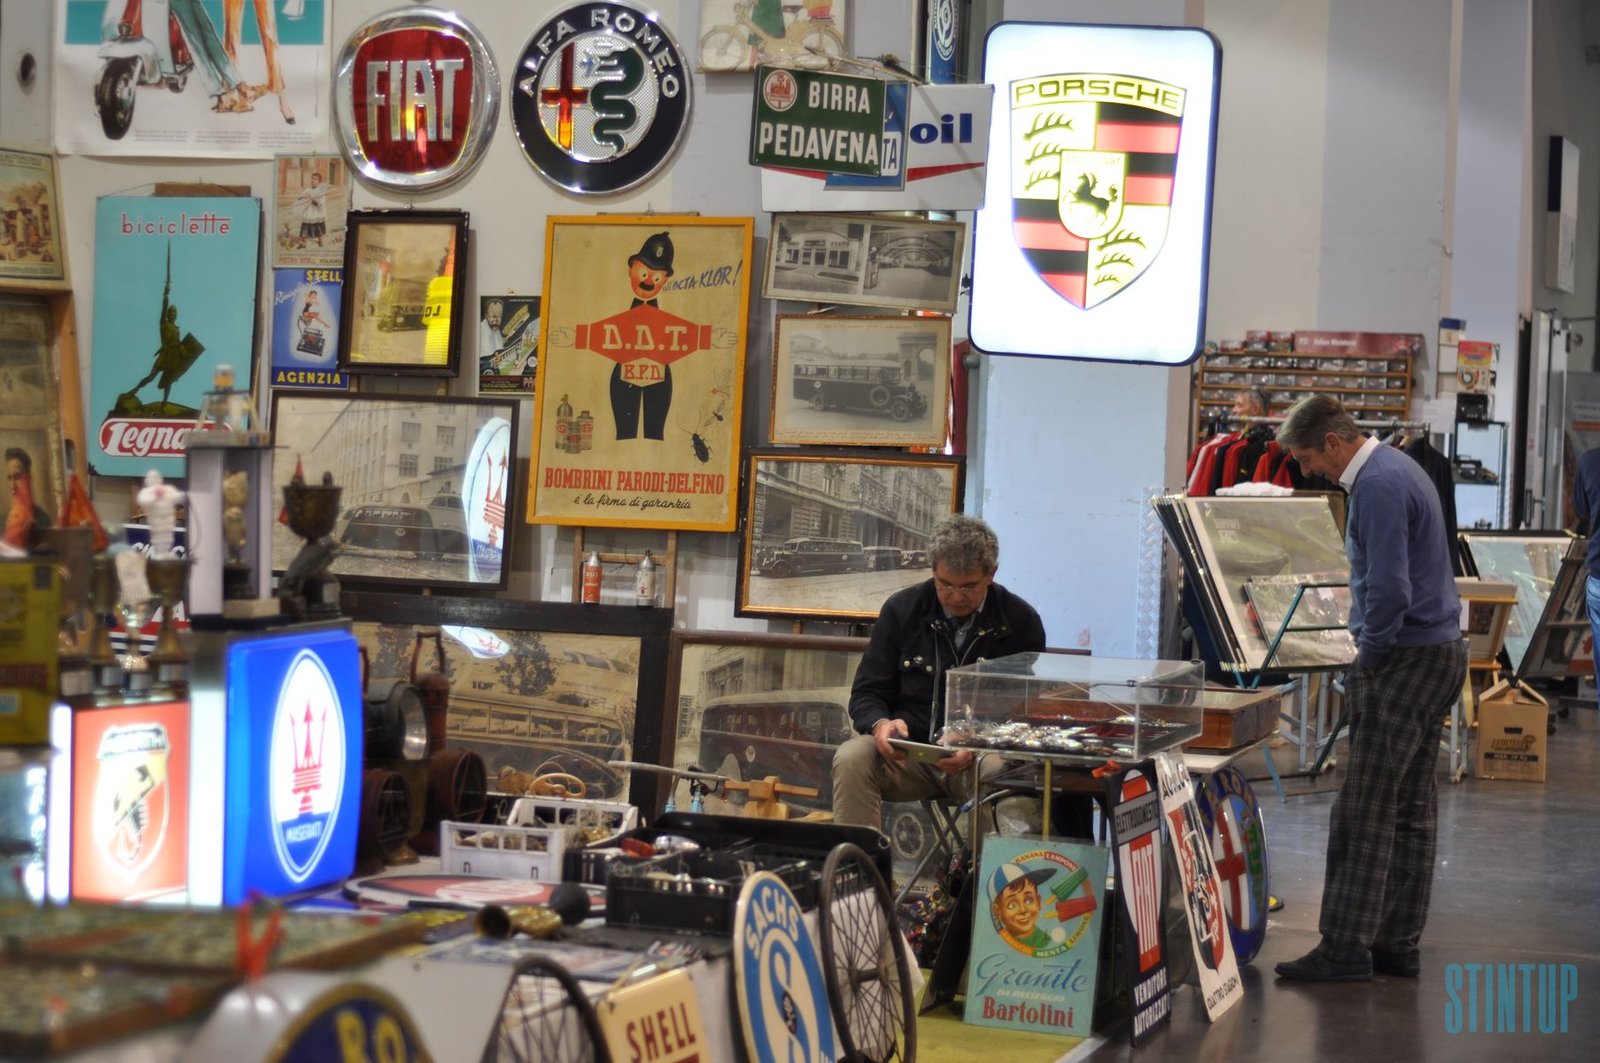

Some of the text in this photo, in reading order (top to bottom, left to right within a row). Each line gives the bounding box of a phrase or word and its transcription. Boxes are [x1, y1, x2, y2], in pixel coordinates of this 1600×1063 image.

[519, 8, 680, 99] ALFA ROMEO
[366, 58, 464, 142] FIAT
[808, 80, 871, 115] BIRRA
[1015, 79, 1180, 110] PORSCHE
[758, 121, 879, 166] PEDAVENA
[121, 213, 231, 235] biciclette
[602, 323, 689, 352] D.D.T.
[276, 370, 342, 386] AGENZIA
[623, 364, 664, 381] B.P.D.
[544, 467, 725, 495] BOMBRINI PARODI-DELFINO
[583, 492, 594, 506] la
[596, 493, 627, 511] firma
[628, 495, 642, 508] di
[641, 498, 693, 512] garanzia
[1131, 843, 1158, 955] FIAT
[747, 885, 799, 960] SACHS
[1037, 944, 1067, 958] MENTA
[975, 952, 1088, 998] Granite
[1134, 965, 1167, 1007] VENDITORE
[982, 995, 1074, 1029] Bartolini
[625, 1002, 697, 1063] SHELL
